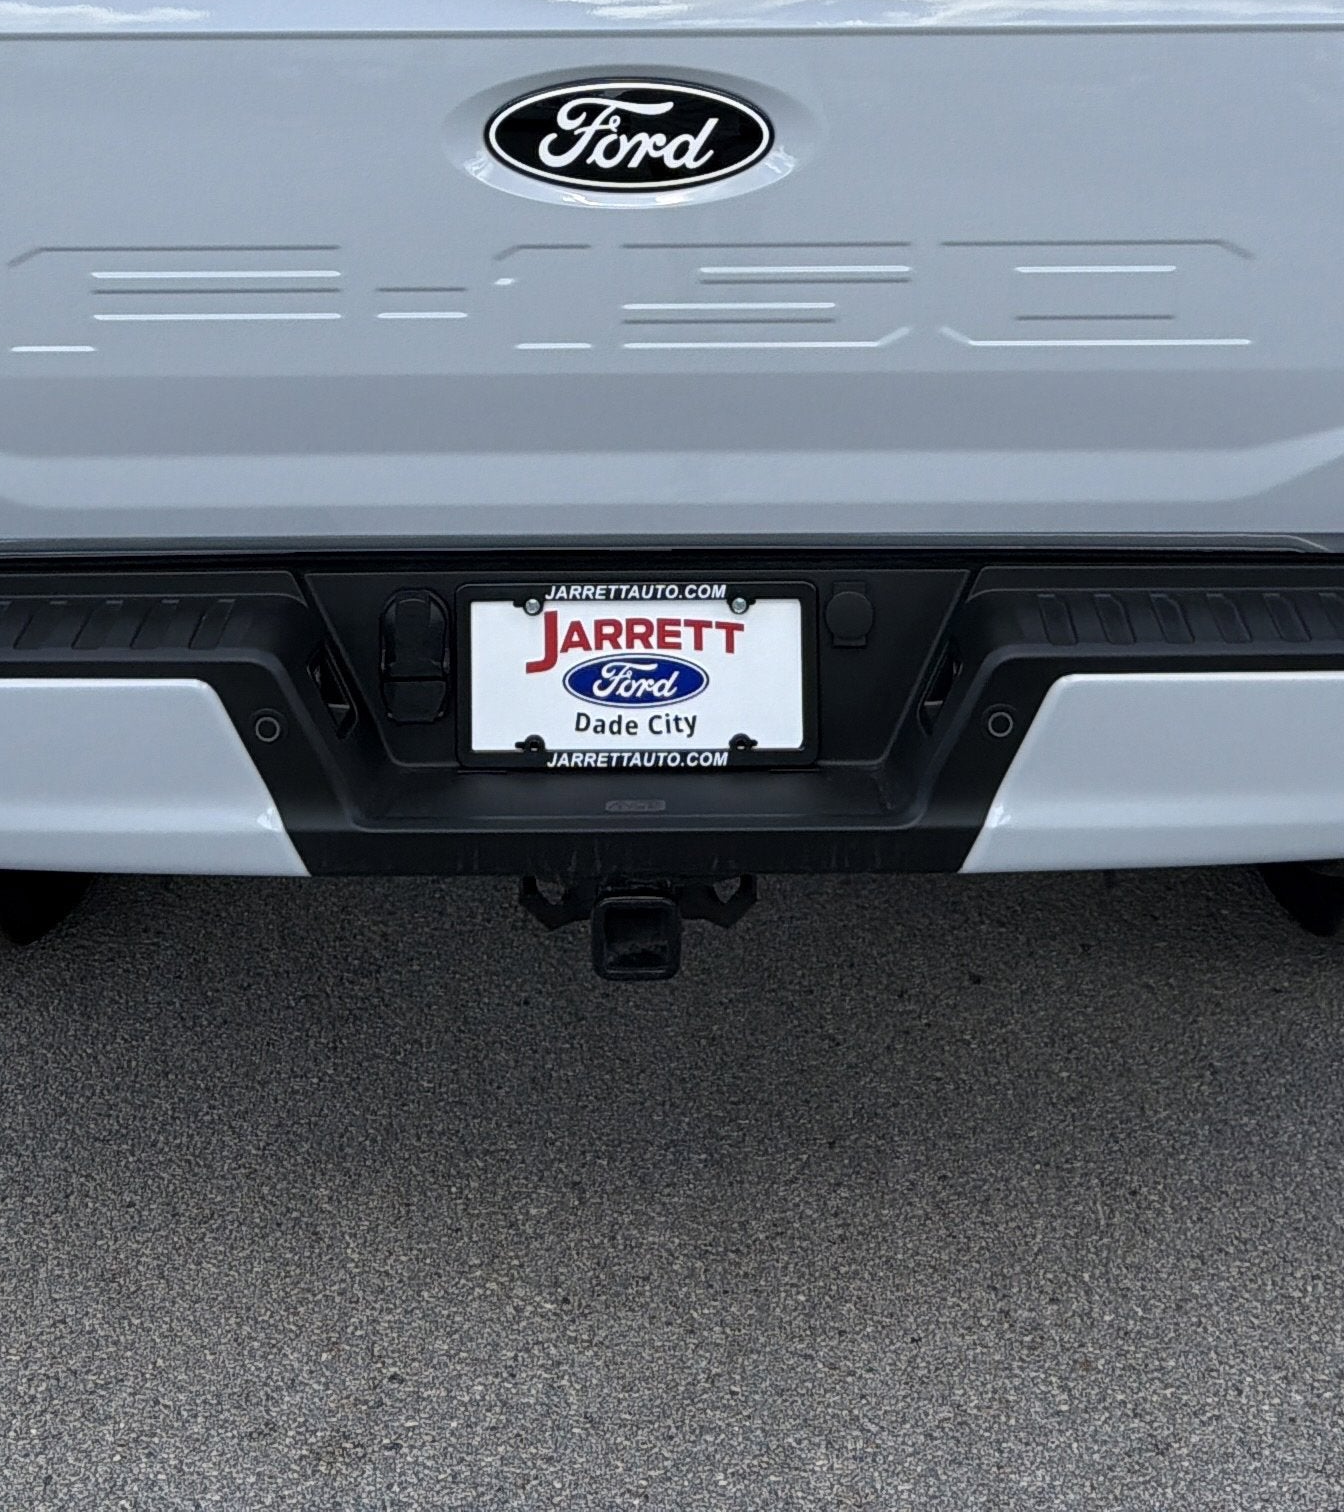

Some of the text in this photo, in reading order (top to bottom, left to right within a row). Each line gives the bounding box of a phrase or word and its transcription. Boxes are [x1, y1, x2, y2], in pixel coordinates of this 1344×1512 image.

[538, 97, 720, 170] Ford
[544, 583, 727, 601] JARRETTAUTO.COM
[525, 609, 745, 675] JARRETT
[592, 660, 680, 699] Ford
[574, 711, 698, 739] Dade City
[546, 750, 729, 769] JARRETTAUTO.COM
